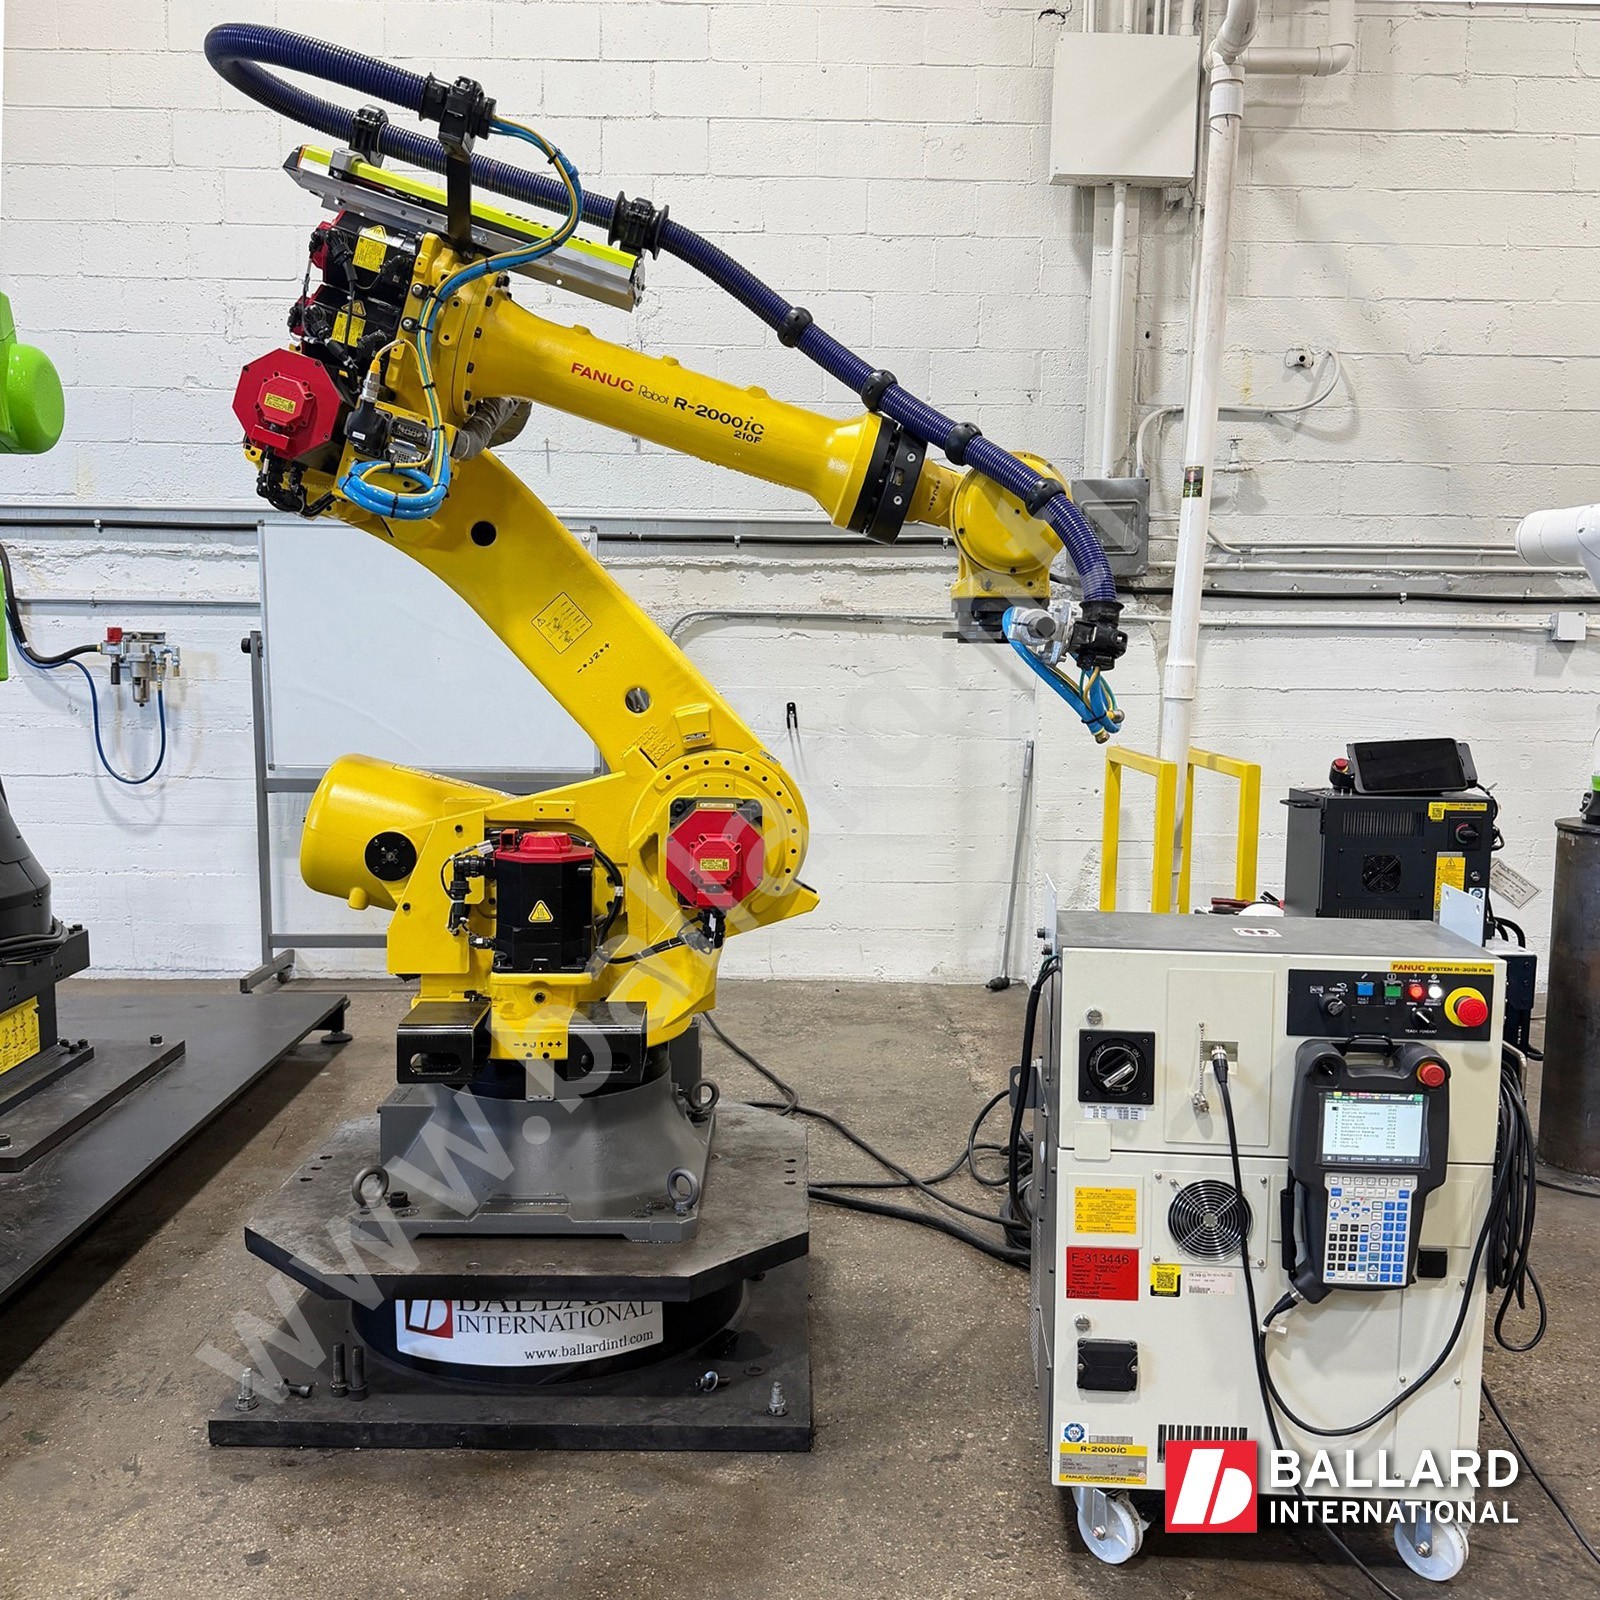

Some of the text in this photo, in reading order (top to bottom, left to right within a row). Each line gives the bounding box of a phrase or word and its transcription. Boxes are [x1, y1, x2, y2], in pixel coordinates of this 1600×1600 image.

[571, 362, 765, 435] FANUC Robot R-2000iC
[733, 429, 762, 444] 210F
[1392, 964, 1425, 972] FANUC
[1071, 1252, 1130, 1265] F-313446
[457, 1301, 653, 1335] INTERNATIONAL
[524, 1329, 654, 1361] www.ballardintl.com
[1080, 1445, 1127, 1454] R-2000iC
